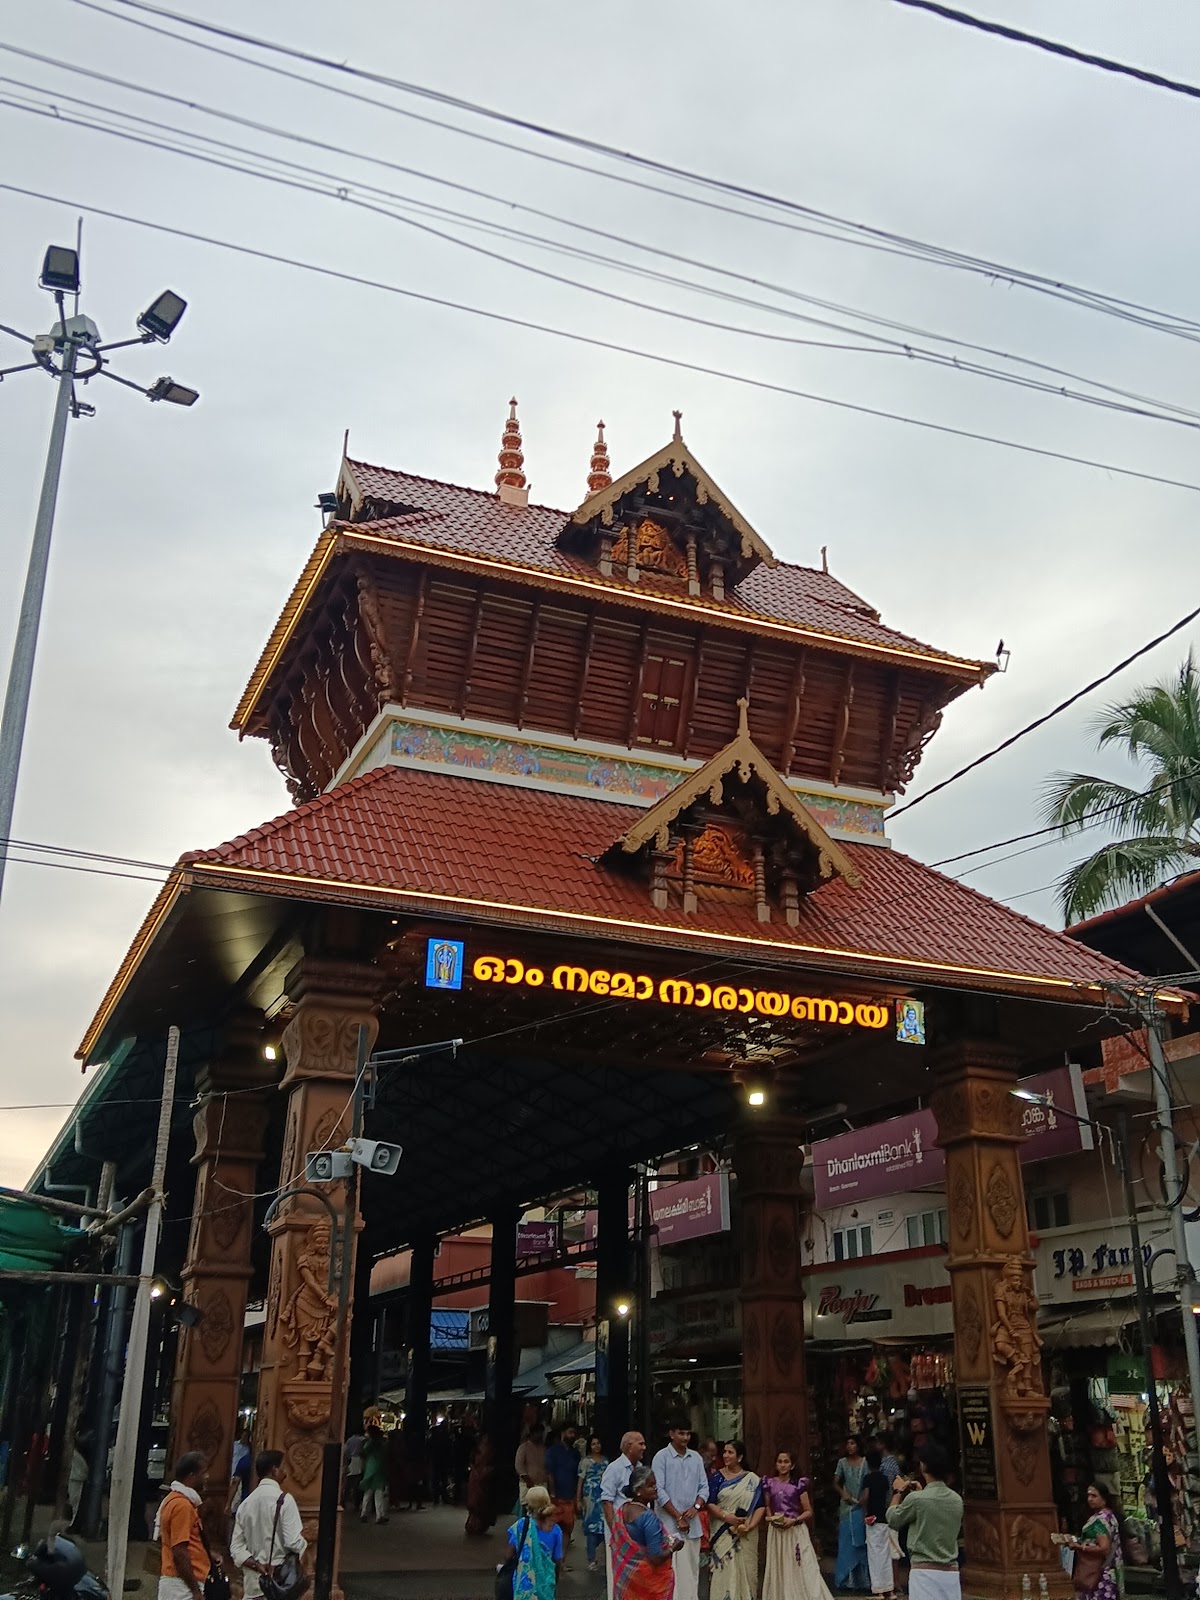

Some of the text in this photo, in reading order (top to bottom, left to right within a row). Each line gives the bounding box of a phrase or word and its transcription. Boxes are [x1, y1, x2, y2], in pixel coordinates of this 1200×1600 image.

[473, 956, 543, 986] ഓം
[550, 965, 653, 999] നമോ
[1091, 1243, 1152, 1275] Fany
